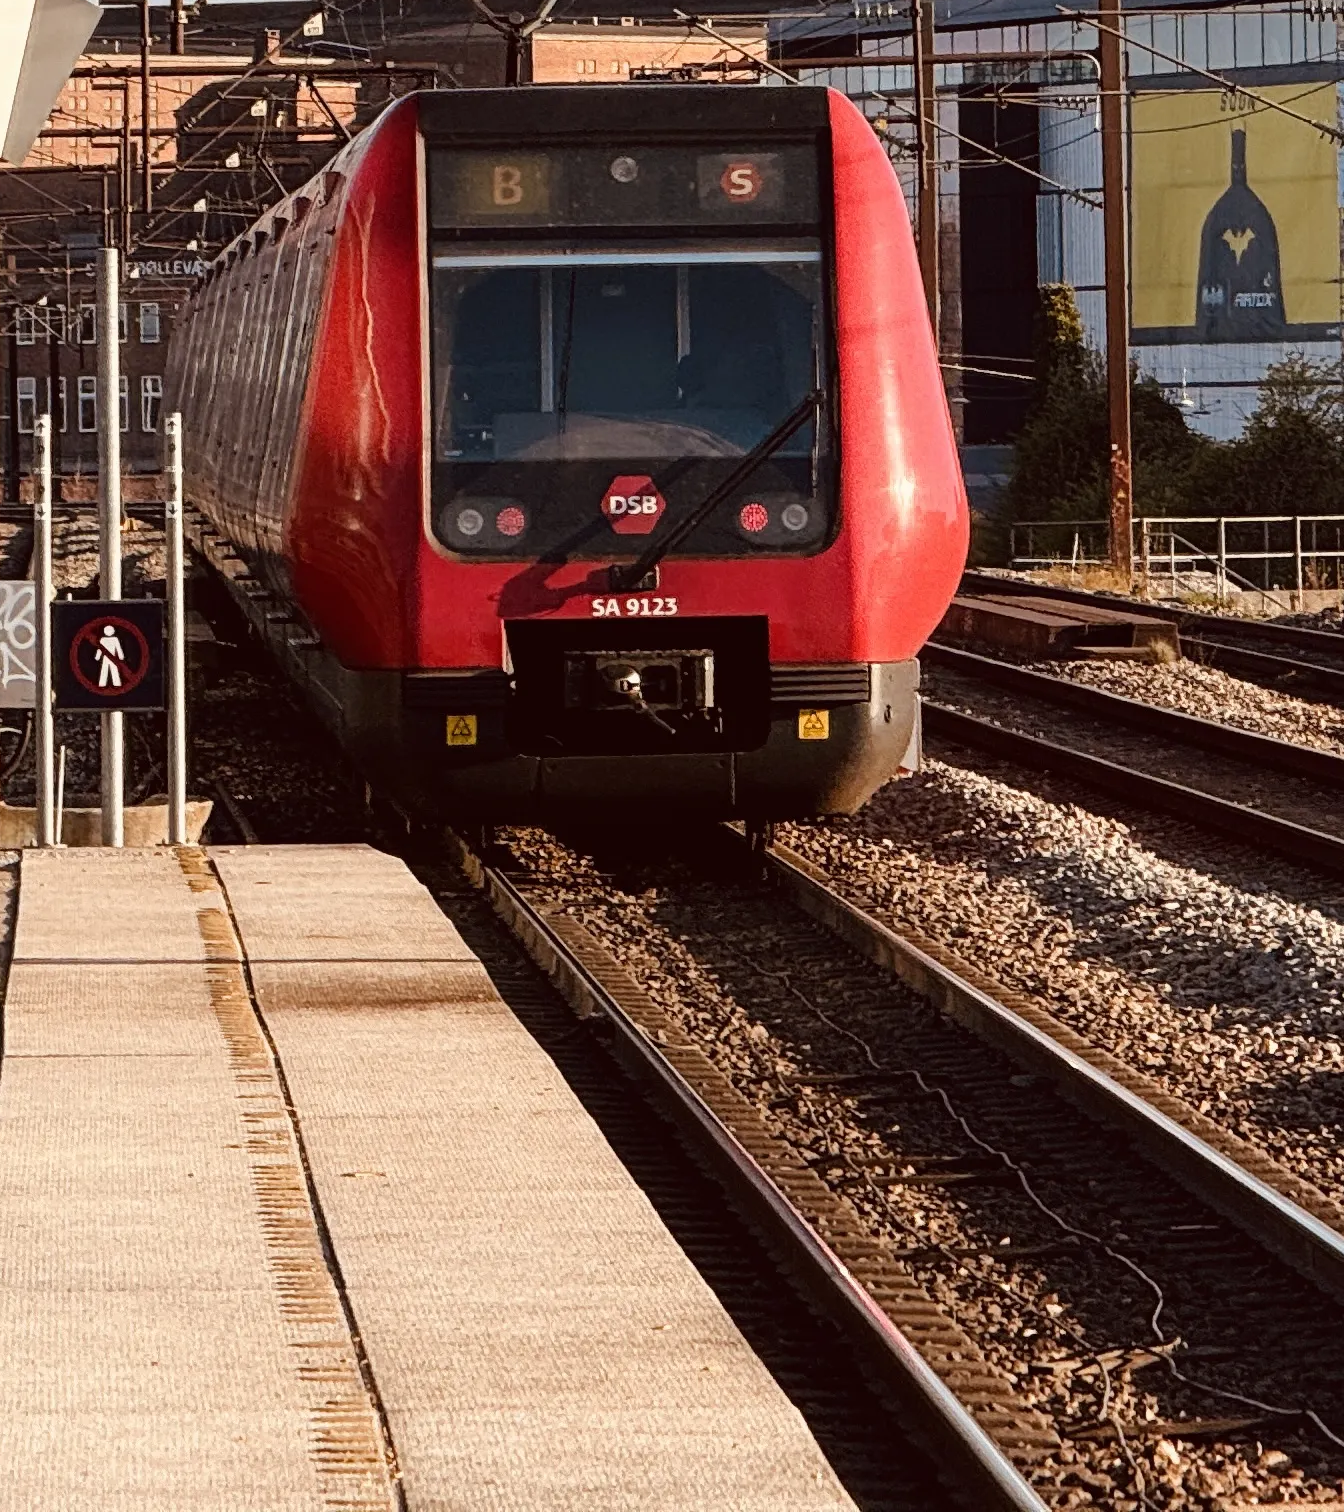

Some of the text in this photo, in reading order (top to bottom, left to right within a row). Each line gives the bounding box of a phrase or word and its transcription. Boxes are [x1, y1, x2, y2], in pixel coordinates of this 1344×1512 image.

[492, 165, 524, 205] B
[729, 169, 754, 196] S
[609, 495, 657, 516] DSB
[591, 597, 678, 617] SA 9123
